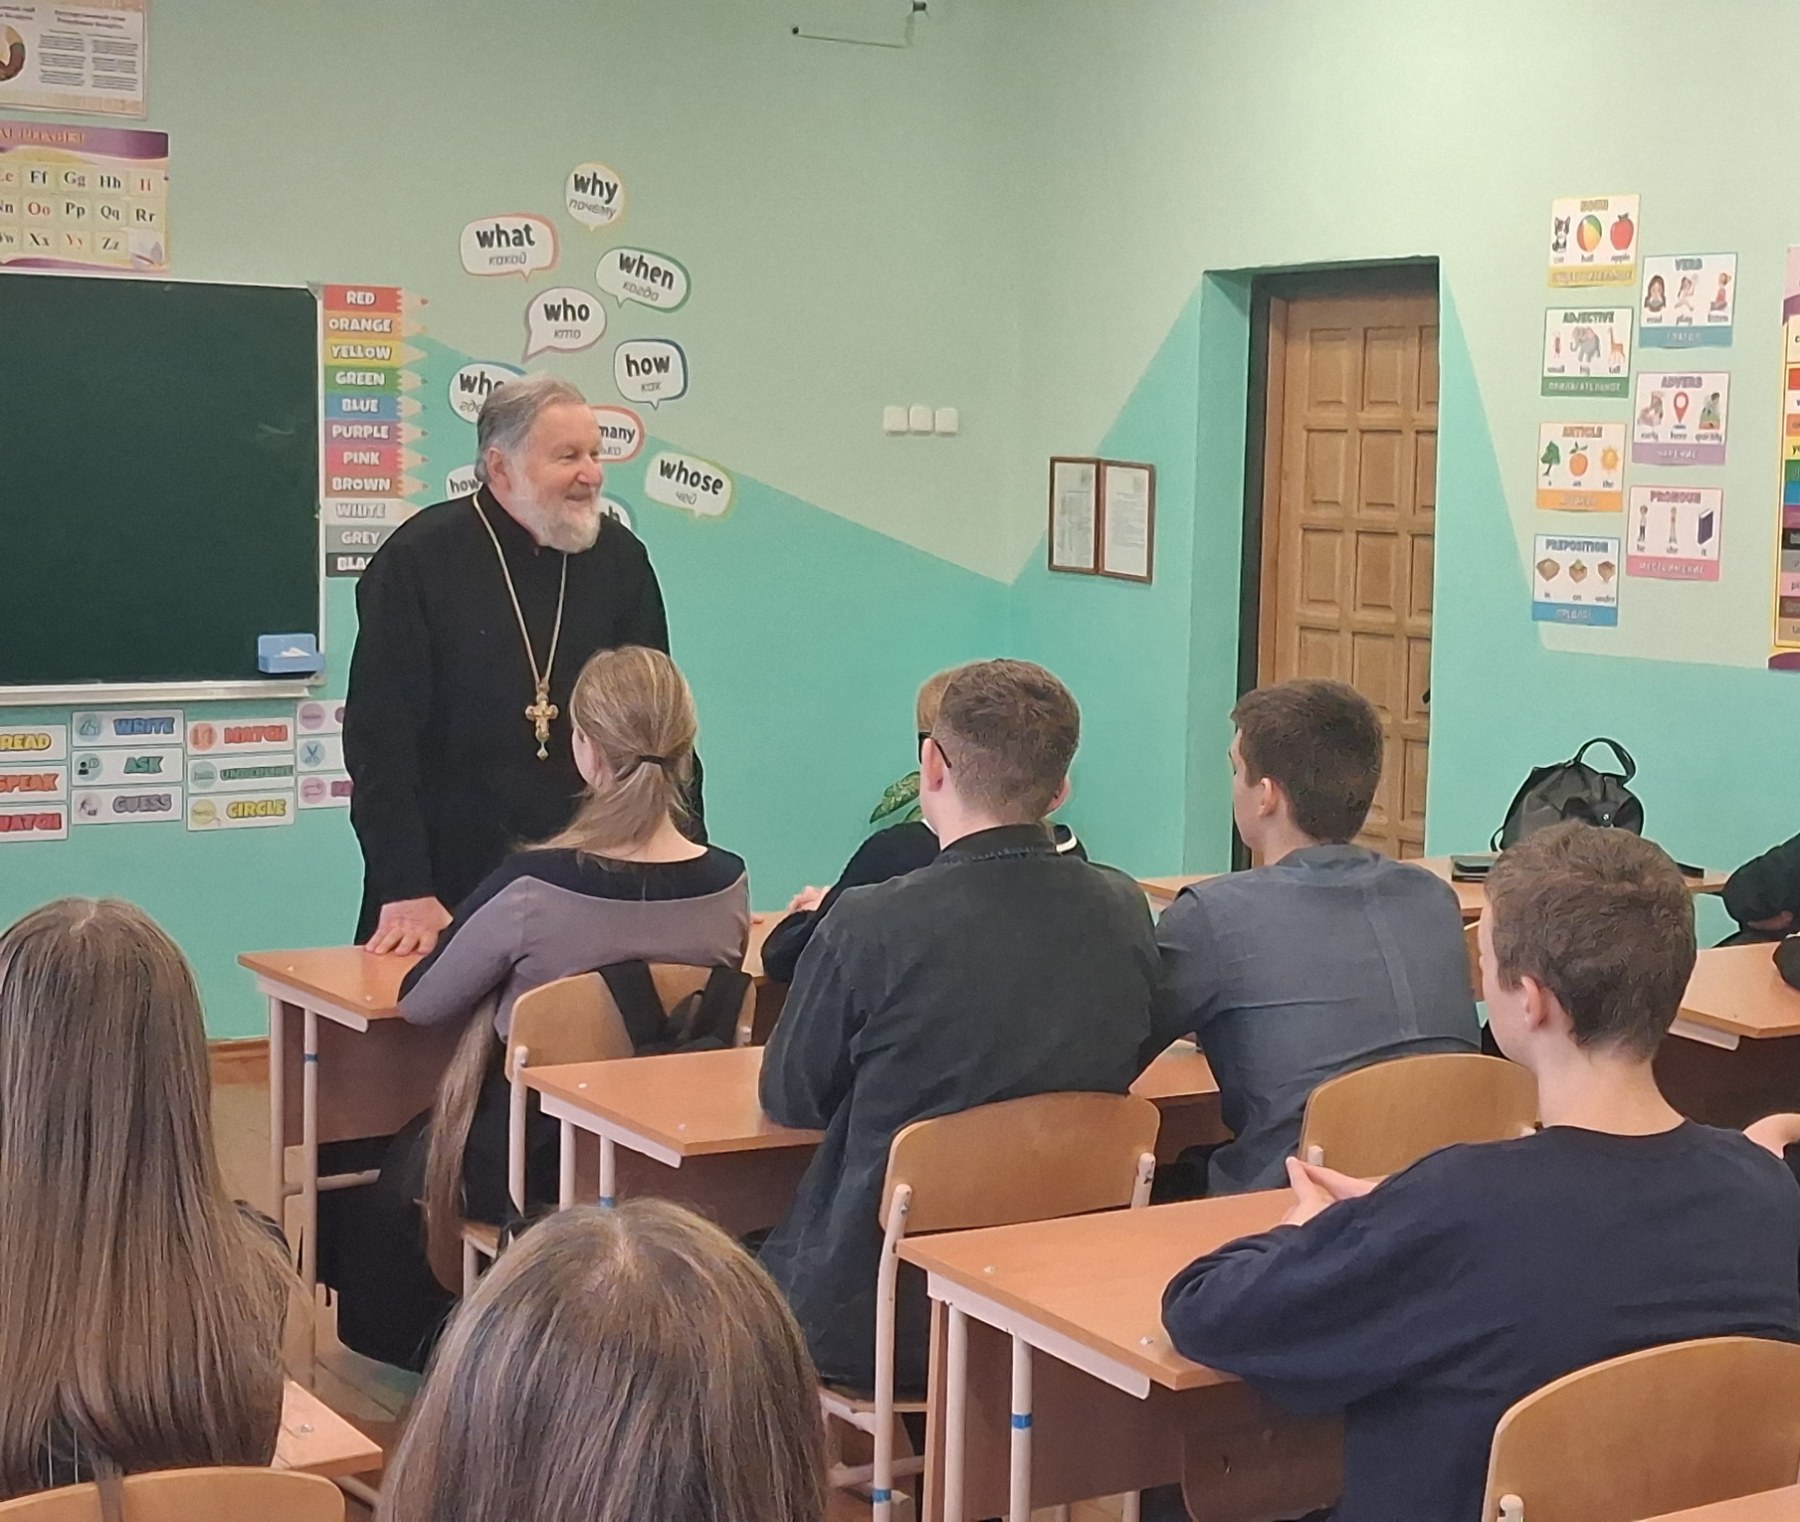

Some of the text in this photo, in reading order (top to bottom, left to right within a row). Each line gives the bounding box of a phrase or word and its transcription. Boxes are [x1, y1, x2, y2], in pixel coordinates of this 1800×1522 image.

[30, 170, 48, 185] Ff
[63, 170, 86, 188] Gg
[99, 174, 121, 190] Hh
[573, 171, 618, 204] why
[27, 201, 51, 216] Oo
[65, 201, 86, 220] Pp
[100, 204, 120, 222] Qq
[135, 207, 156, 223] Rr
[569, 199, 616, 220] почему
[29, 232, 50, 248] Xx
[476, 223, 536, 249] what
[488, 251, 527, 267] какой
[619, 252, 675, 290] when
[345, 291, 376, 306] RED
[543, 297, 592, 323] who
[1562, 310, 1615, 324] ADJECTIVE
[328, 318, 393, 334] ORANGE
[553, 328, 582, 340] кто
[330, 344, 392, 361] YELLOW
[624, 353, 671, 378] how
[335, 370, 386, 387] GREEN
[1661, 375, 1703, 390] ADVERB
[341, 397, 379, 414] BLUE
[331, 424, 391, 440] PURPLE
[342, 451, 381, 466] PINK
[331, 477, 391, 493] BROWN
[657, 458, 724, 496] whose
[340, 530, 381, 546] GREY
[1545, 538, 1610, 554] PREPOSITION
[113, 717, 175, 736] WRITE
[223, 724, 288, 745] MATCH
[123, 755, 164, 774] ASK
[112, 794, 172, 814] GUESS
[226, 798, 287, 819] CIRCLE
